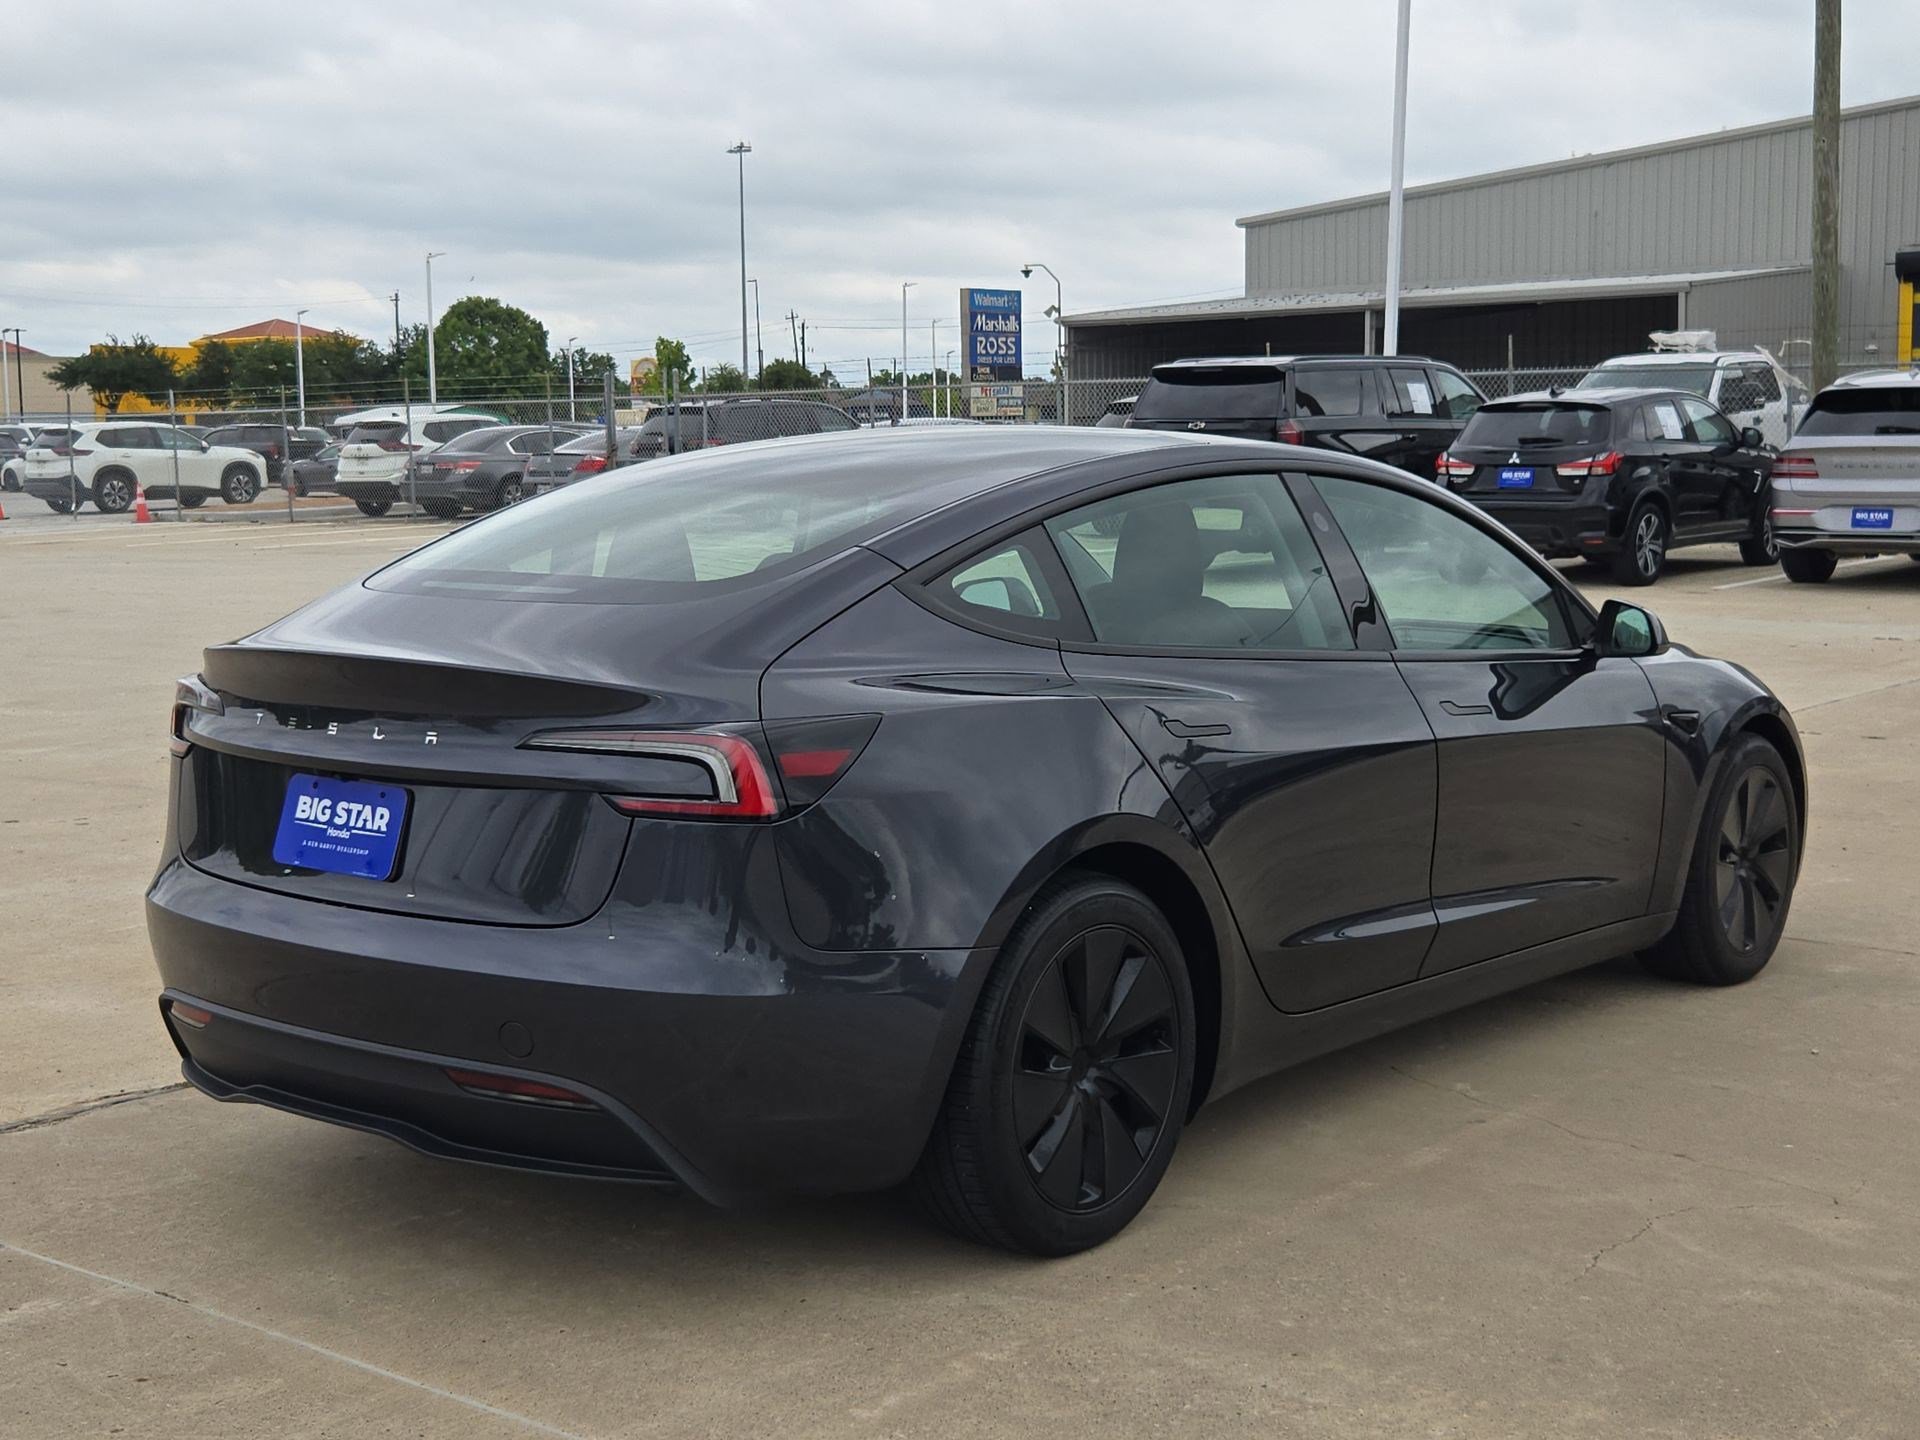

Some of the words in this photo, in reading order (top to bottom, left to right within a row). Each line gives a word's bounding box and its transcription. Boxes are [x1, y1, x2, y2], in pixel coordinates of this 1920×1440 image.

[974, 292, 1008, 308] Walmart
[973, 314, 1020, 332] Marshalls
[977, 336, 1016, 354] ROSS
[1501, 471, 1513, 479] BIG
[1514, 471, 1531, 479] STAR
[1856, 512, 1869, 520] BIG
[1870, 512, 1889, 520] STAR
[256, 712, 438, 745] TESLA
[294, 795, 333, 824] BIG
[333, 800, 390, 832] STAR
[326, 826, 350, 840] Honda
[336, 845, 369, 856] DEALERSHIP
